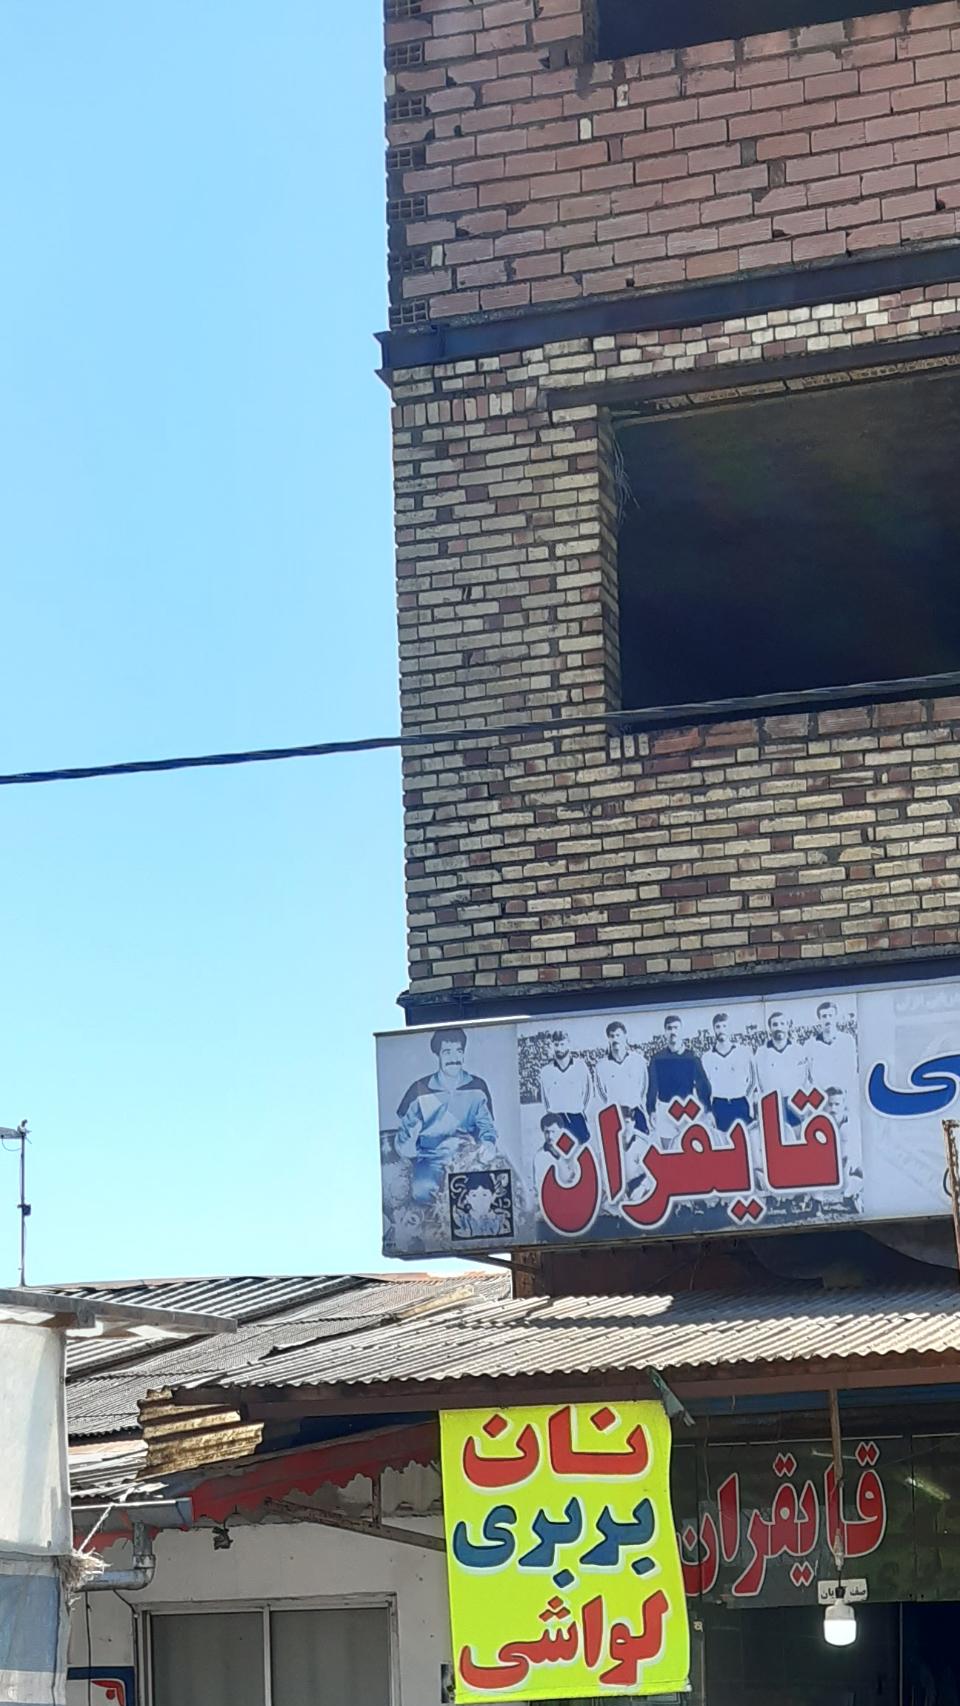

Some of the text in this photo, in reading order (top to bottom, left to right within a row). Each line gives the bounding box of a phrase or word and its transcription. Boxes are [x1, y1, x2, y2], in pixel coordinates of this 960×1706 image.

[462, 1405, 650, 1488] نان
[453, 1497, 656, 1589] بربری
[459, 1589, 669, 1690] لواشی
